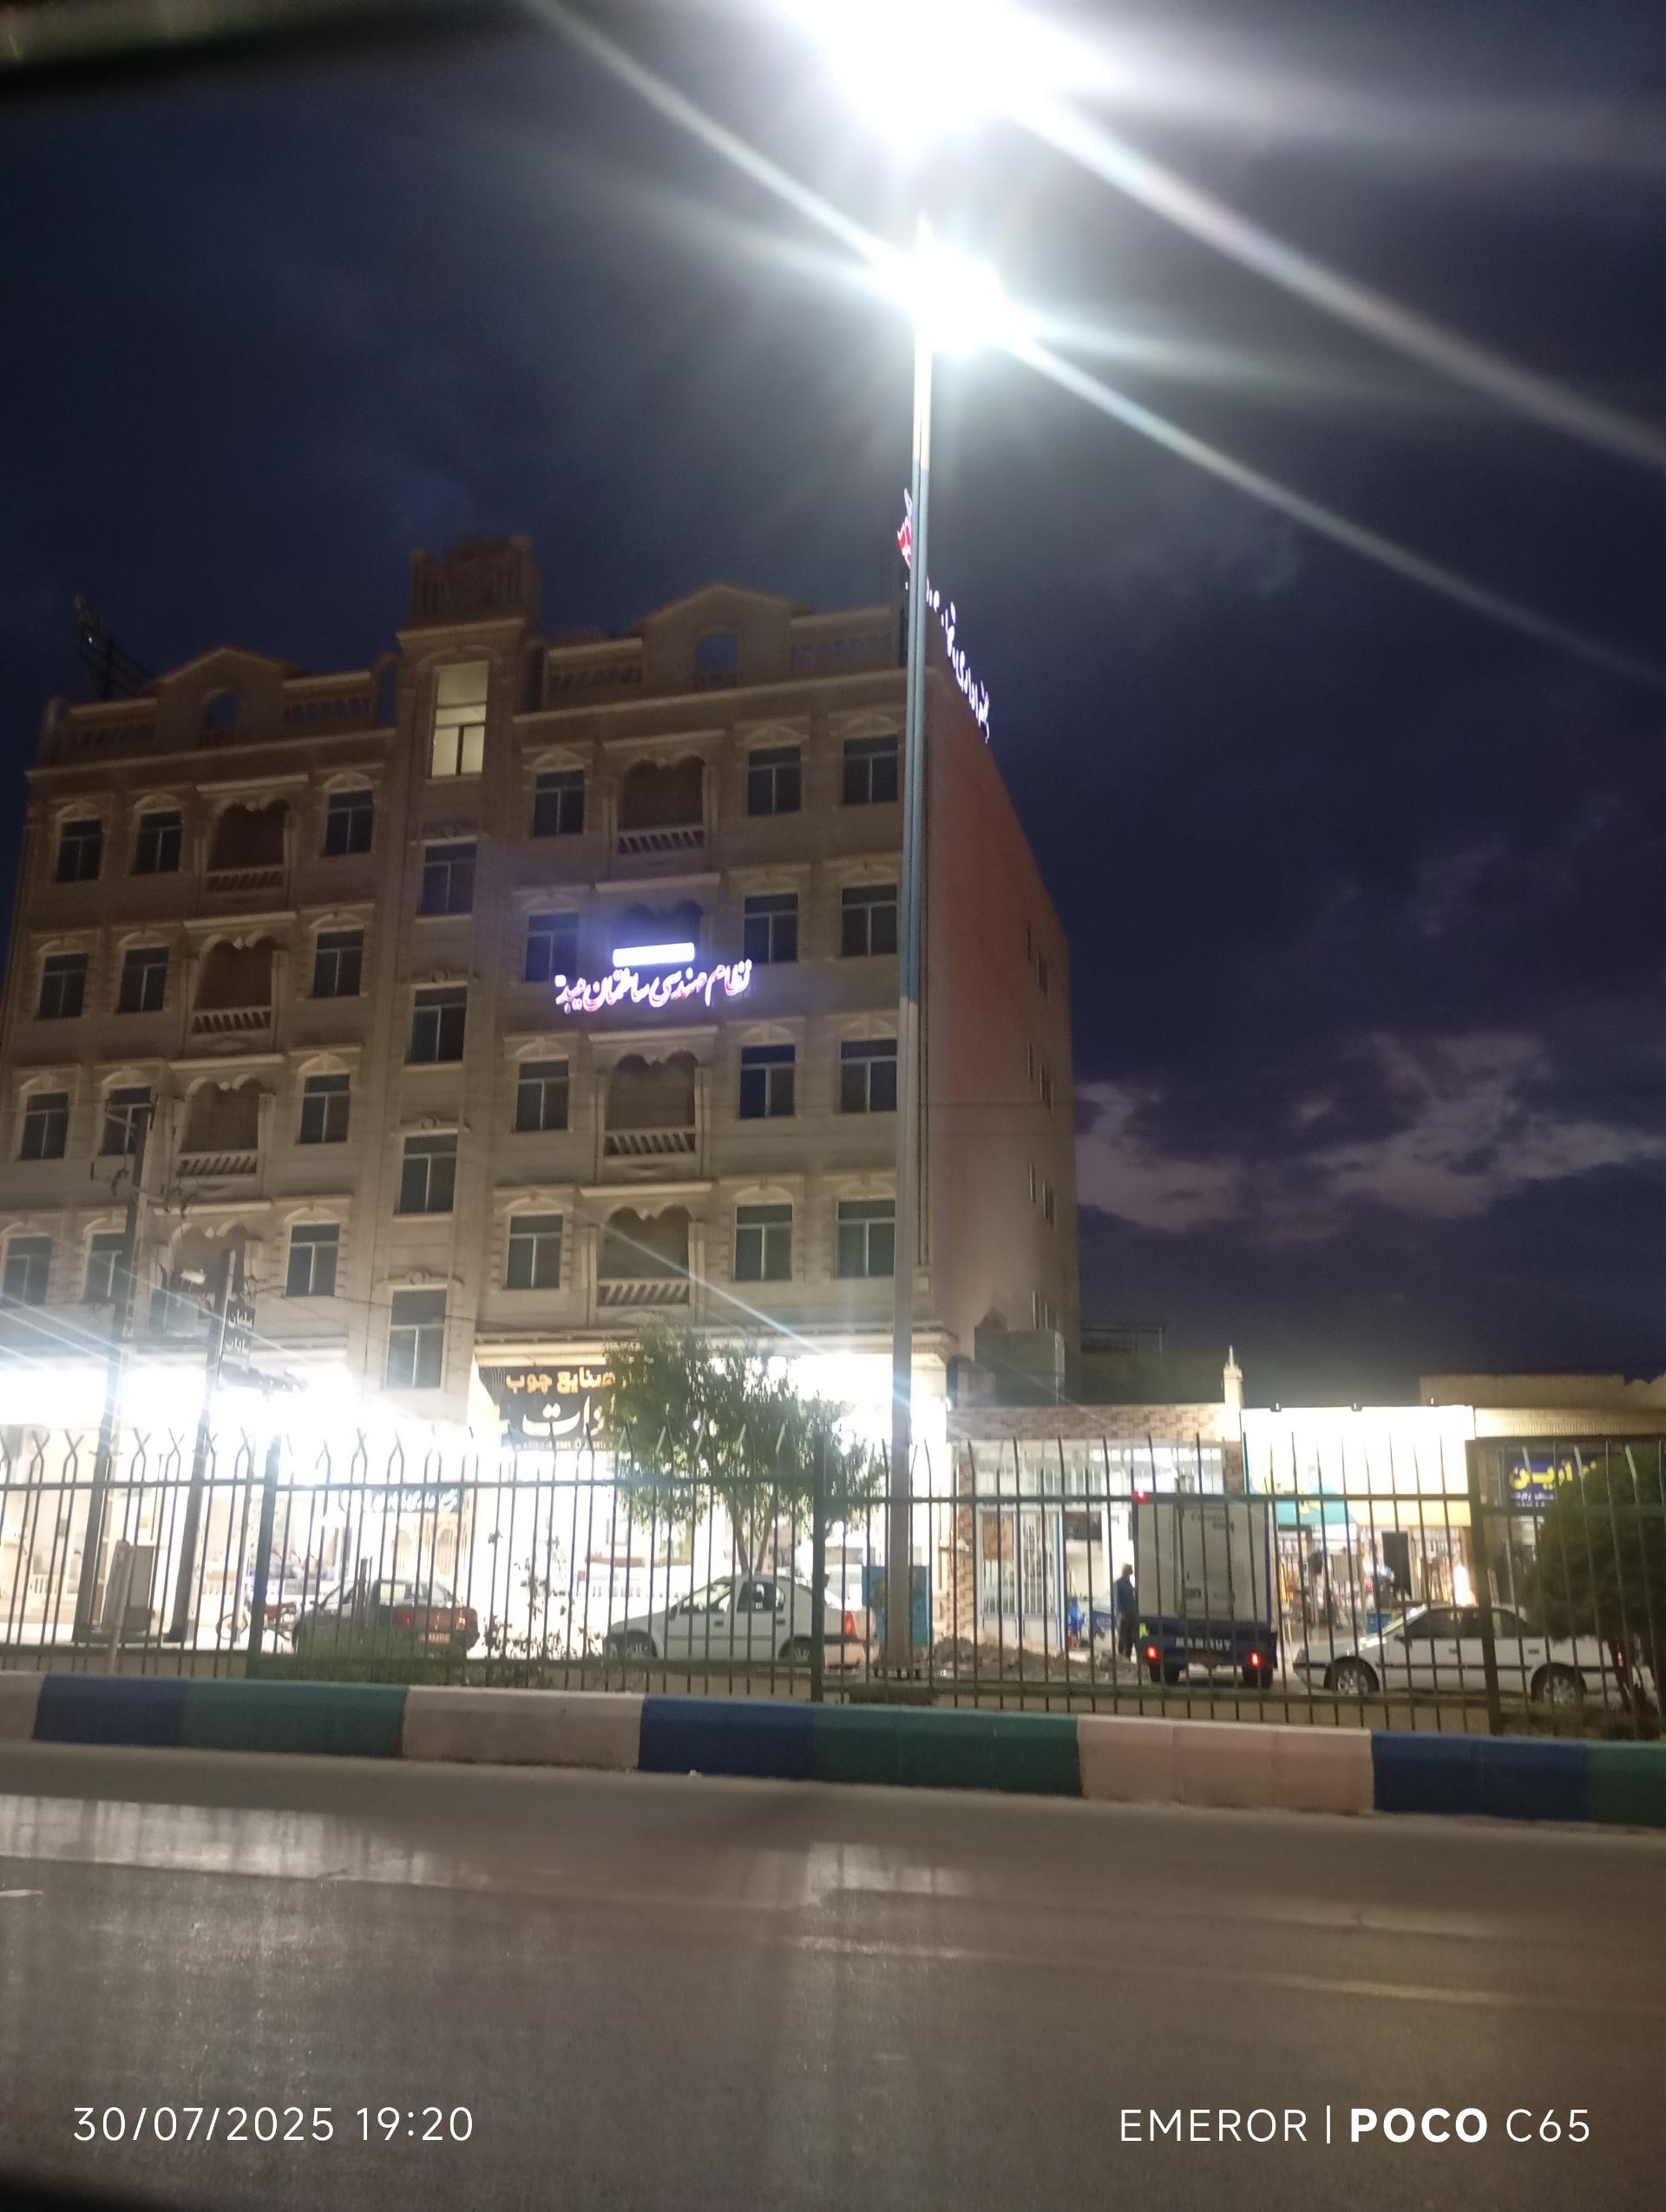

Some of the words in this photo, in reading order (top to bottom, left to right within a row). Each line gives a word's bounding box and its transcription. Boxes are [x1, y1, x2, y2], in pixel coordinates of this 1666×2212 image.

[582, 966, 650, 1012] ساختمان
[649, 967, 708, 1008] مهندسی
[505, 1373, 553, 1395] چوب
[556, 1366, 616, 1394] صنایع
